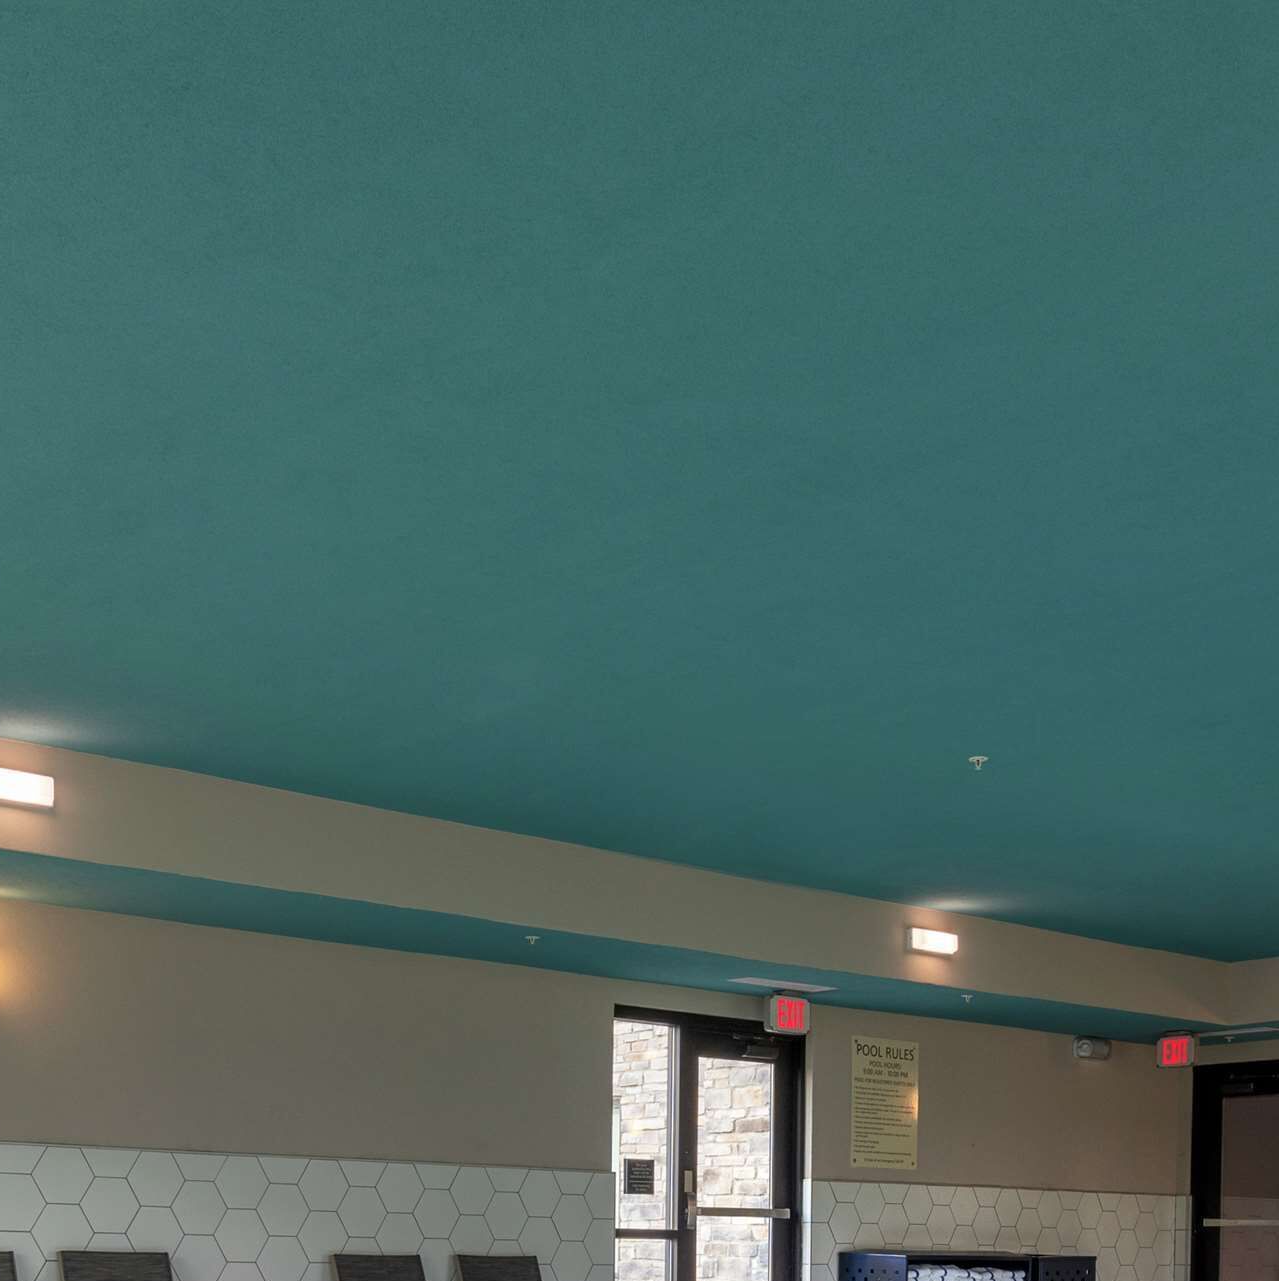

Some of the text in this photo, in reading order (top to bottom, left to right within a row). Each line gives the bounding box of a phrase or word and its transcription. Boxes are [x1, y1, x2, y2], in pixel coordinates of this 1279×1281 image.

[776, 997, 807, 1031] EXIT
[856, 1043, 914, 1061] POOL RULES
[1161, 1038, 1189, 1066] EXIT
